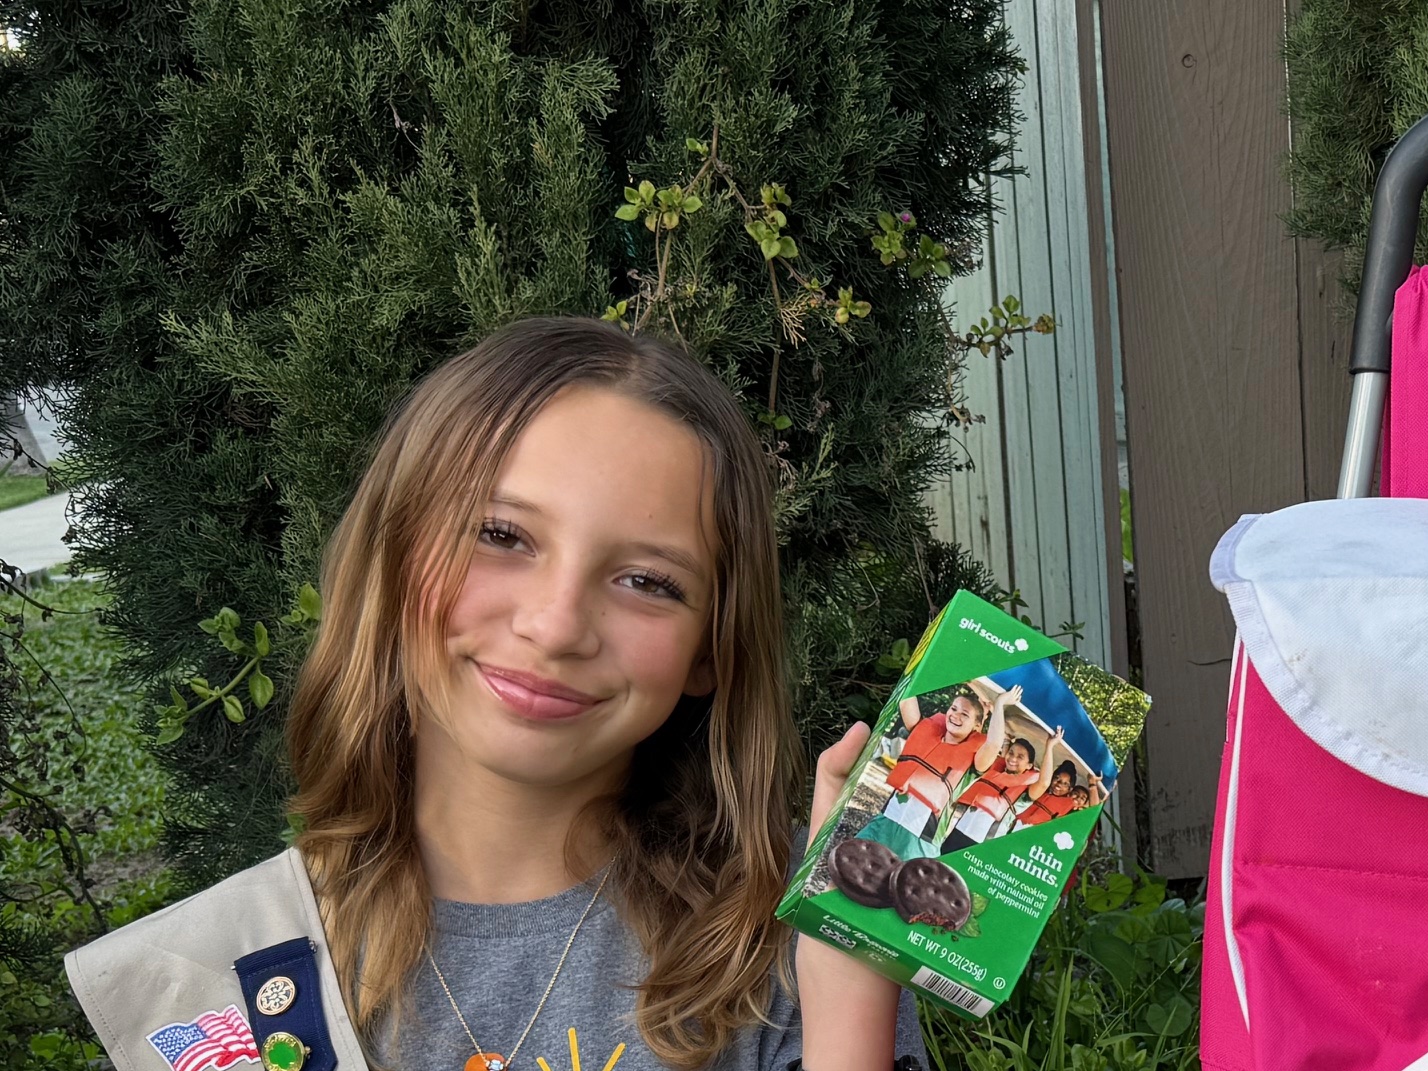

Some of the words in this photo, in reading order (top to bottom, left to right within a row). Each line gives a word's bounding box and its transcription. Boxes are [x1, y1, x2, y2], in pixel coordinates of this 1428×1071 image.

[959, 618, 981, 633] girl
[979, 629, 1015, 653] scouts
[1029, 845, 1063, 872] thin
[963, 851, 983, 868] Crisp,
[985, 864, 1020, 887] chocolaty
[1020, 884, 1048, 901] cookies
[967, 866, 989, 880] made
[990, 877, 1006, 890] with
[1007, 886, 1033, 904] natural
[1033, 900, 1044, 910] oil
[987, 887, 996, 895] of
[995, 891, 1040, 918] peppermint
[907, 930, 926, 946] NET
[925, 939, 941, 955] WT
[939, 948, 947, 958] 9
